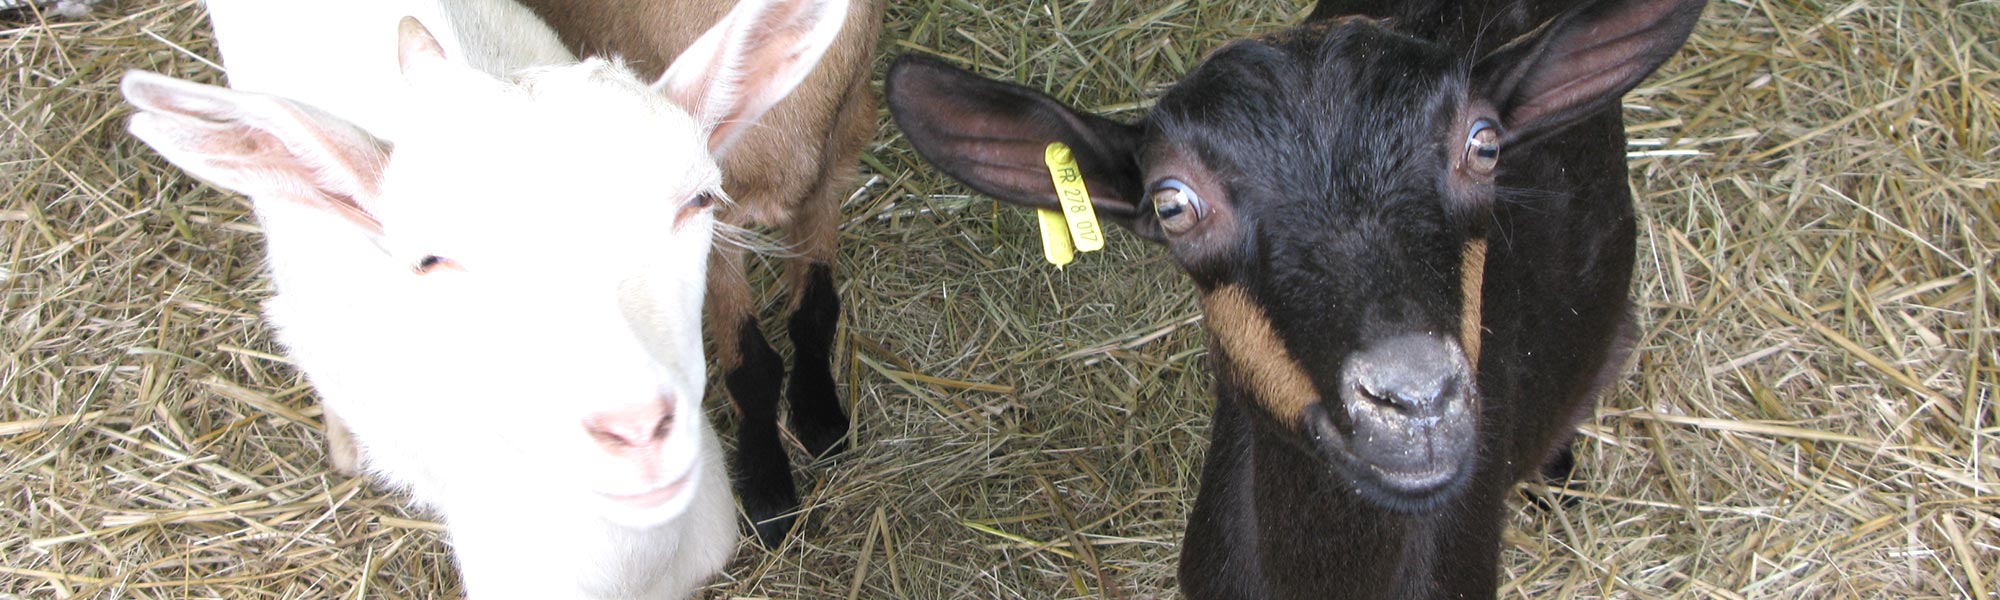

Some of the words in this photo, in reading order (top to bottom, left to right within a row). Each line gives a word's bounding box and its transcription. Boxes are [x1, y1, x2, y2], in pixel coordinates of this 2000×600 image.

[1057, 168, 1077, 184] FR
[1064, 189, 1086, 213] 278
[1077, 221, 1098, 242] 017
